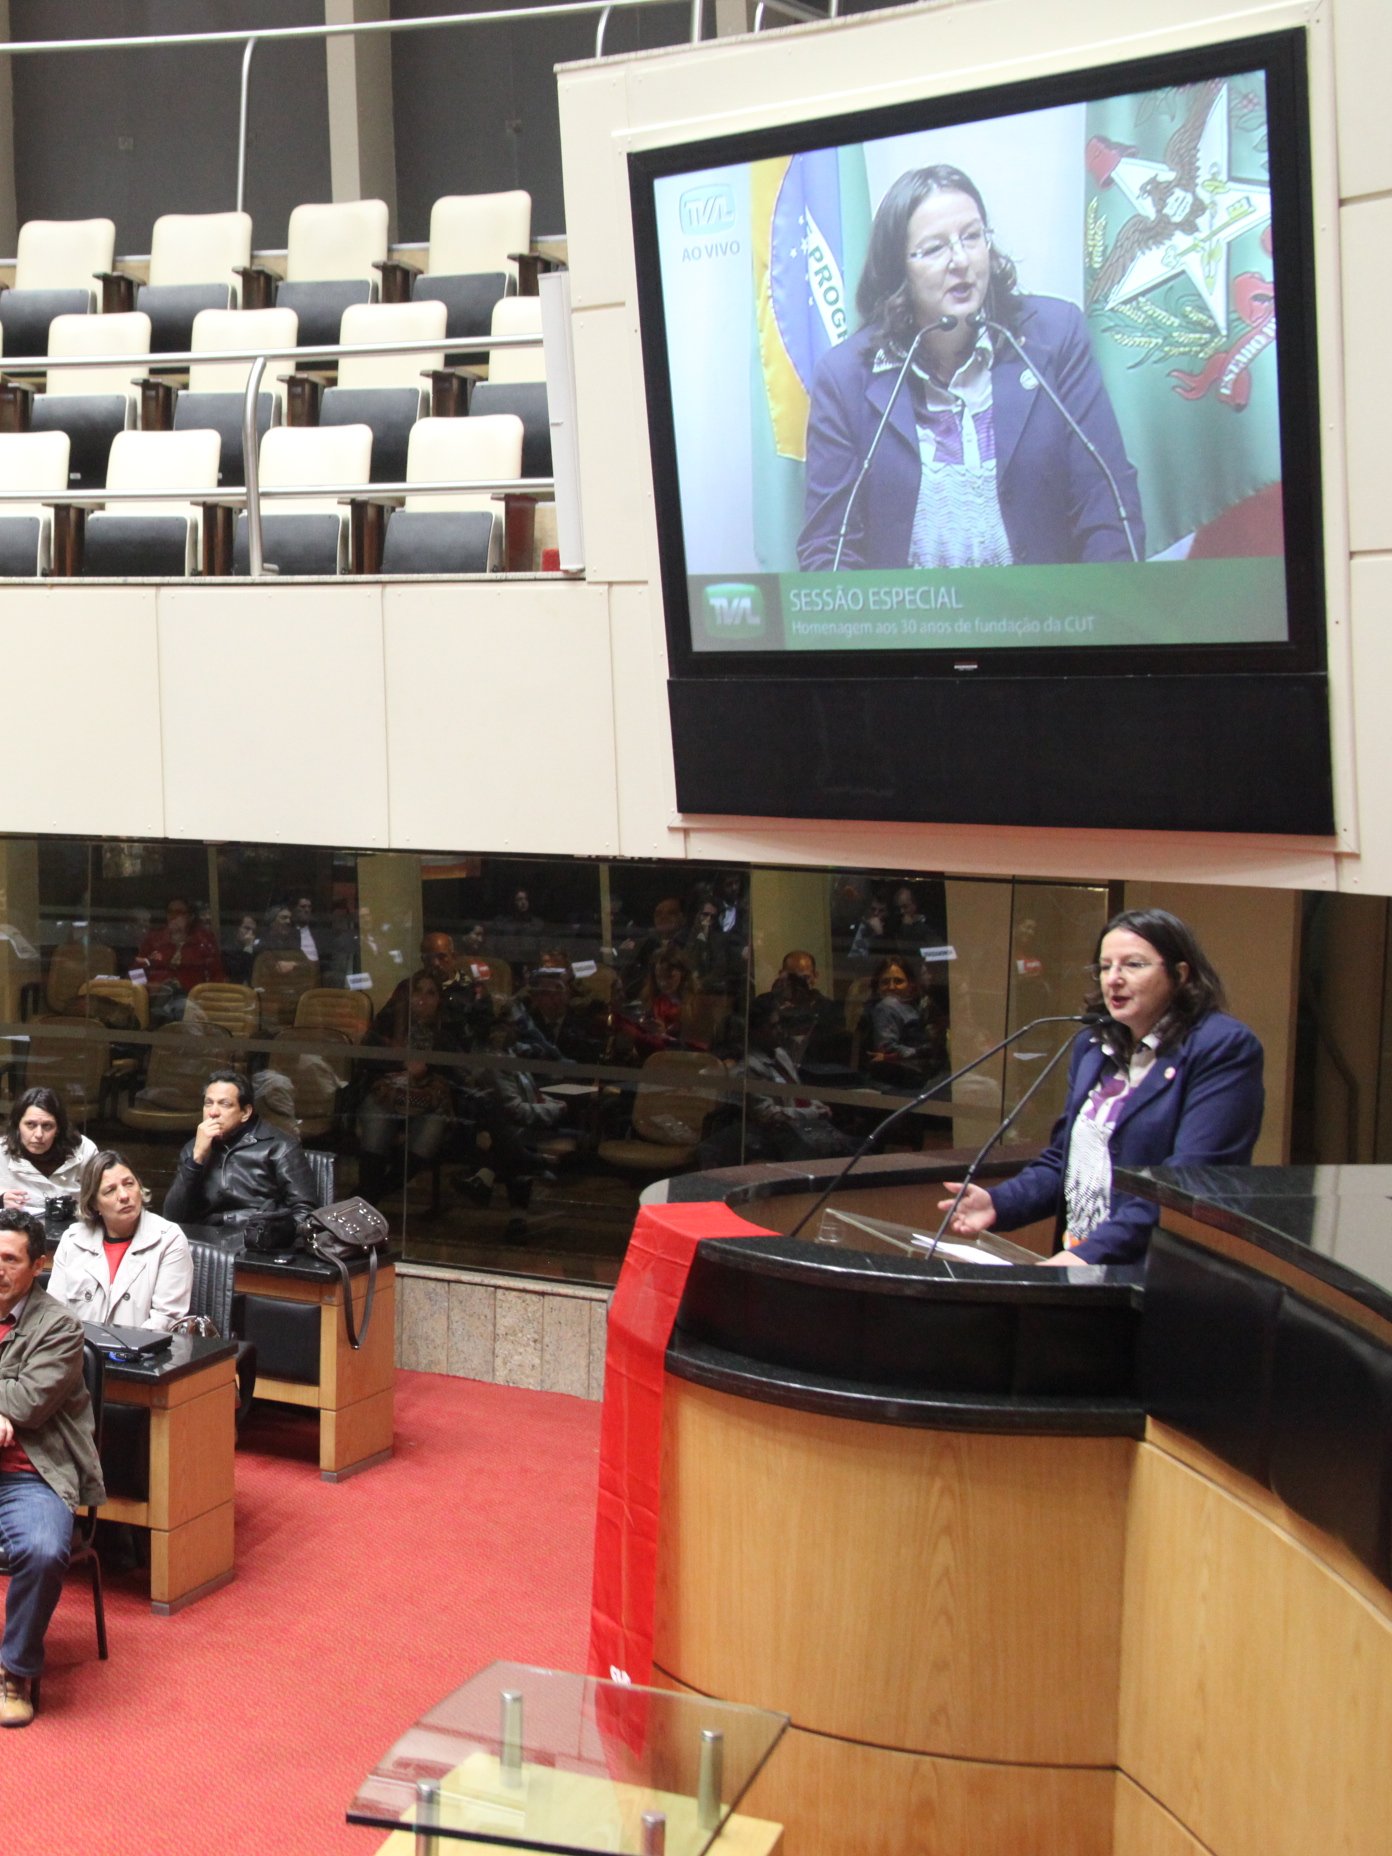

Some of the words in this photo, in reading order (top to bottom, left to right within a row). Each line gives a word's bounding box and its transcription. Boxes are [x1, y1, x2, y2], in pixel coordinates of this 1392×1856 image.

[682, 246, 702, 262] AO
[705, 240, 741, 259] VIVO
[789, 585, 864, 612] SESSÃO
[868, 586, 964, 611] ESPECIAL
[792, 619, 873, 638] Homenagem
[875, 621, 898, 635] aos
[901, 619, 917, 634] 30
[919, 621, 952, 634] anos
[954, 619, 972, 633] de
[974, 617, 1041, 637] fundação
[1043, 617, 1062, 632] da
[1064, 616, 1096, 633] CUT
